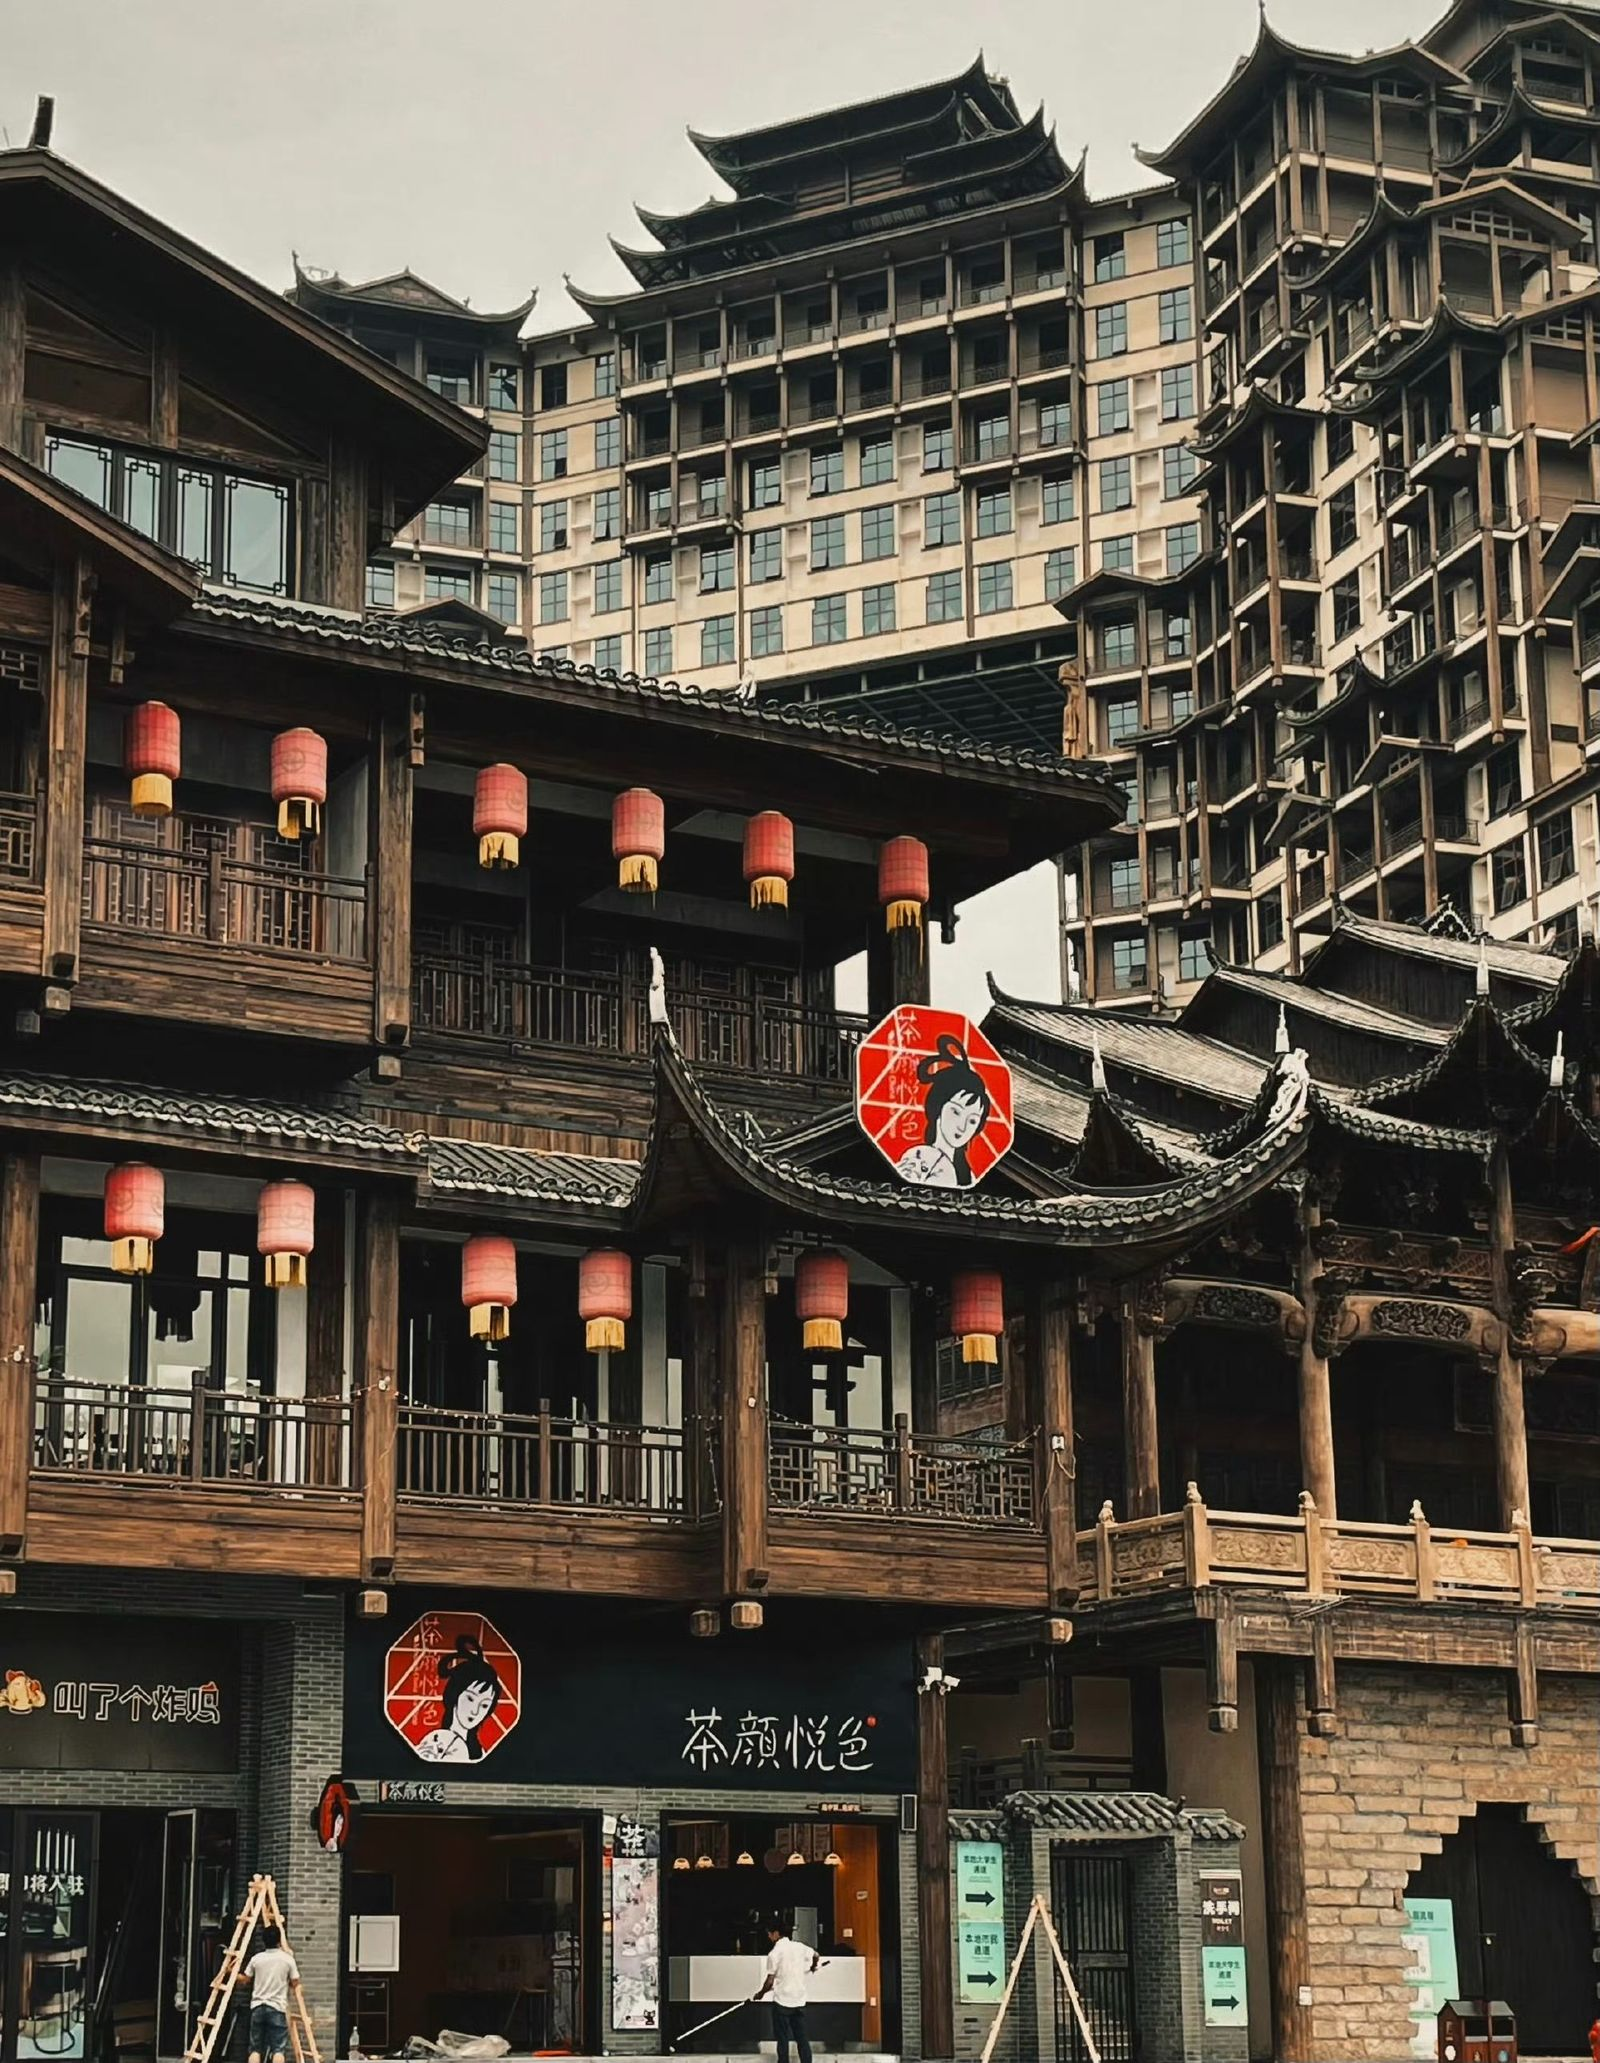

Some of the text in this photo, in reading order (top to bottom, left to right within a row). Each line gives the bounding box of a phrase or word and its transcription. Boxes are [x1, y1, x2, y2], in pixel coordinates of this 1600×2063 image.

[54, 1682, 220, 1724] 叫了个炸鸡
[23, 1874, 85, 1896] 将入驻
